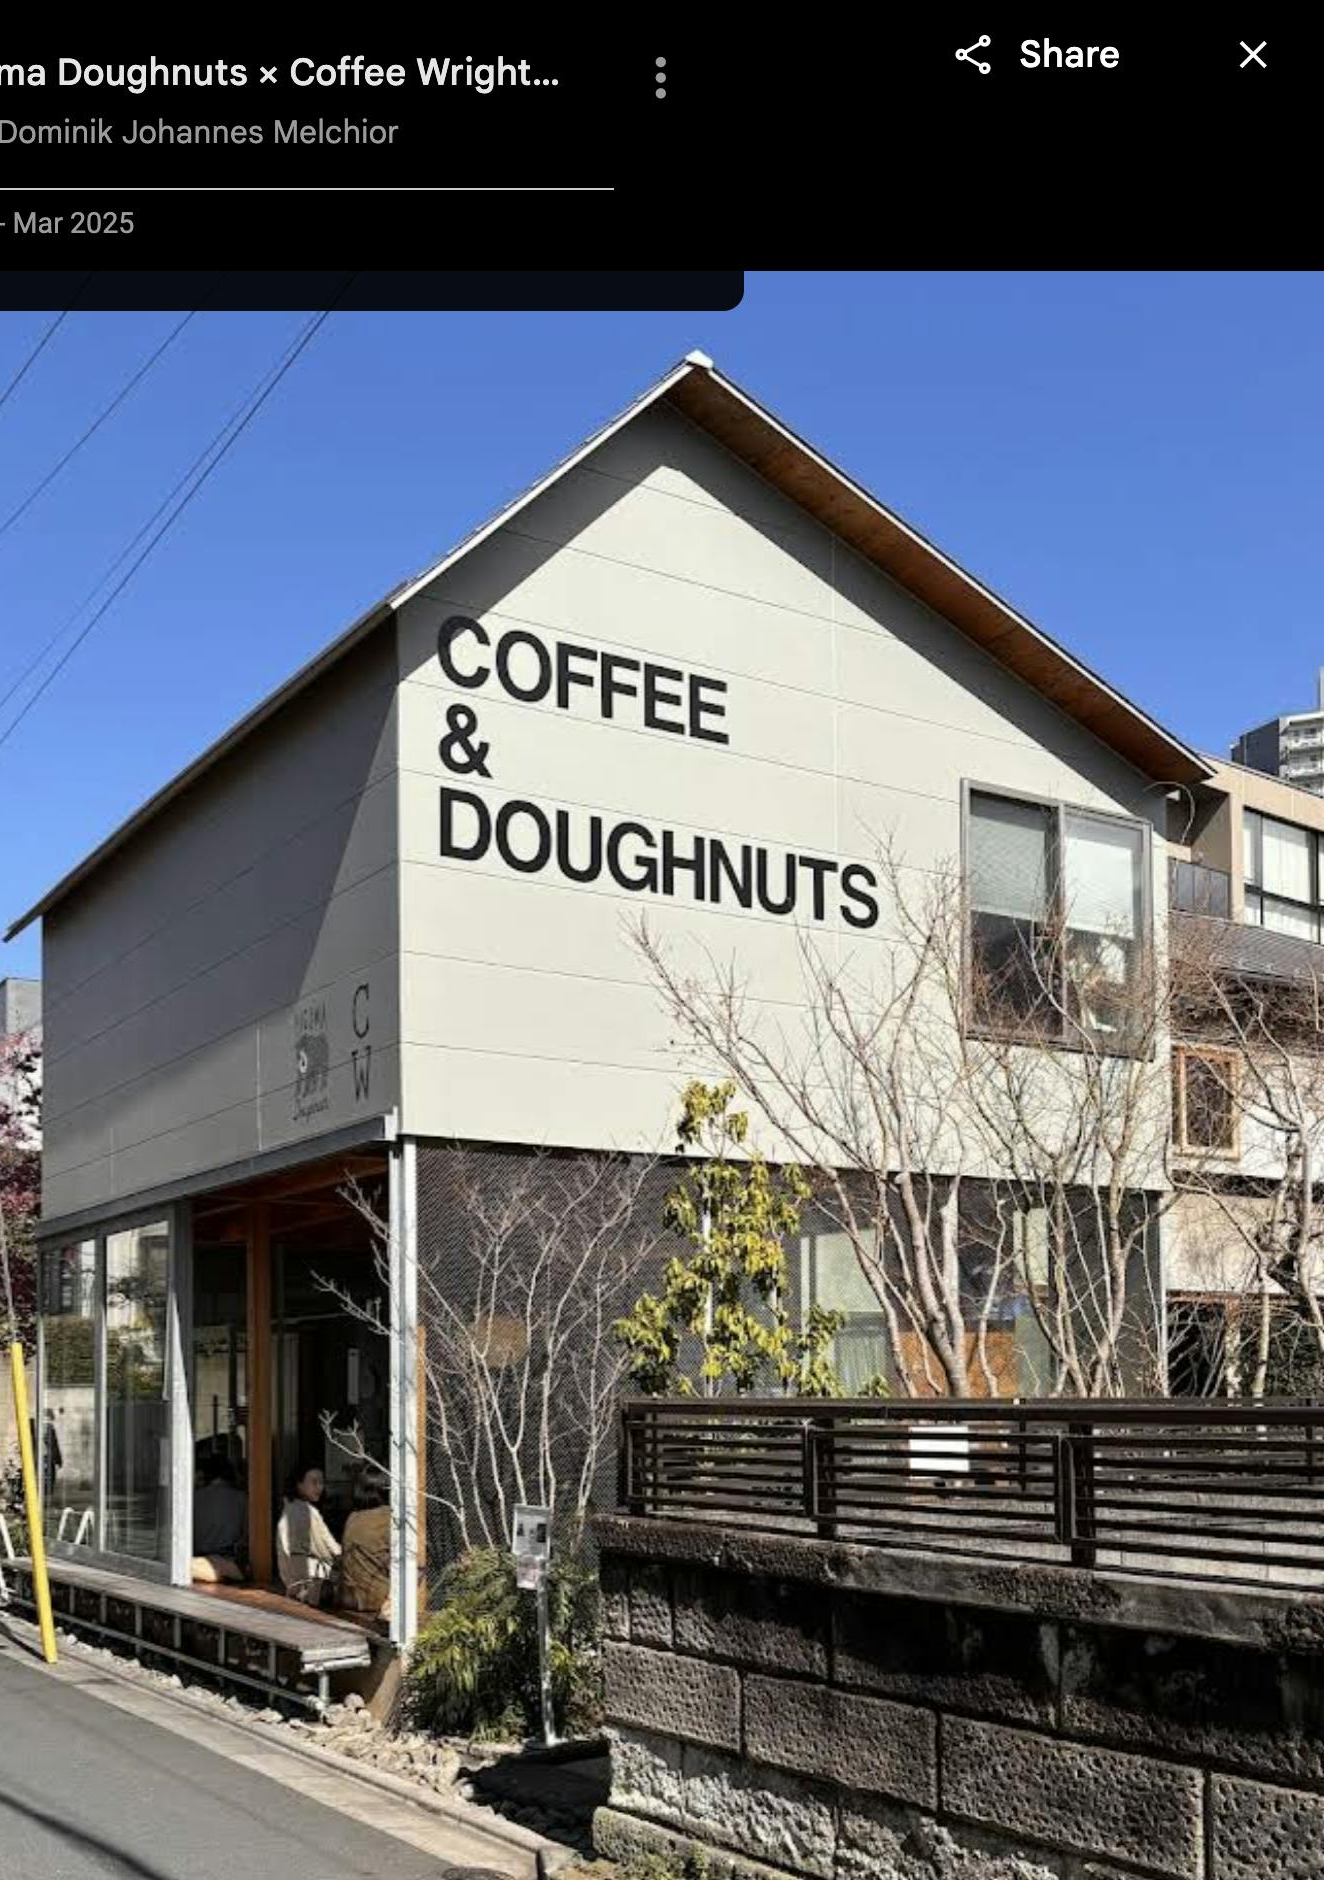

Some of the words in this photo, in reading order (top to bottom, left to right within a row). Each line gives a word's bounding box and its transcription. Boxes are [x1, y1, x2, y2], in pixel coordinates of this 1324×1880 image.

[59, 56, 247, 94] Doughnuts
[291, 55, 405, 86] Coffee
[416, 56, 558, 94] Wright...
[1020, 38, 1119, 68] Share
[122, 118, 263, 144] Johannes
[275, 118, 399, 144] Melchior
[14, 212, 63, 233] Mar
[71, 212, 134, 233] 2025
[436, 615, 729, 745] COFFEE
[438, 703, 492, 778] &
[439, 786, 880, 929] DOUGHNUTS
[352, 982, 369, 1039] C
[351, 1045, 371, 1102] W
